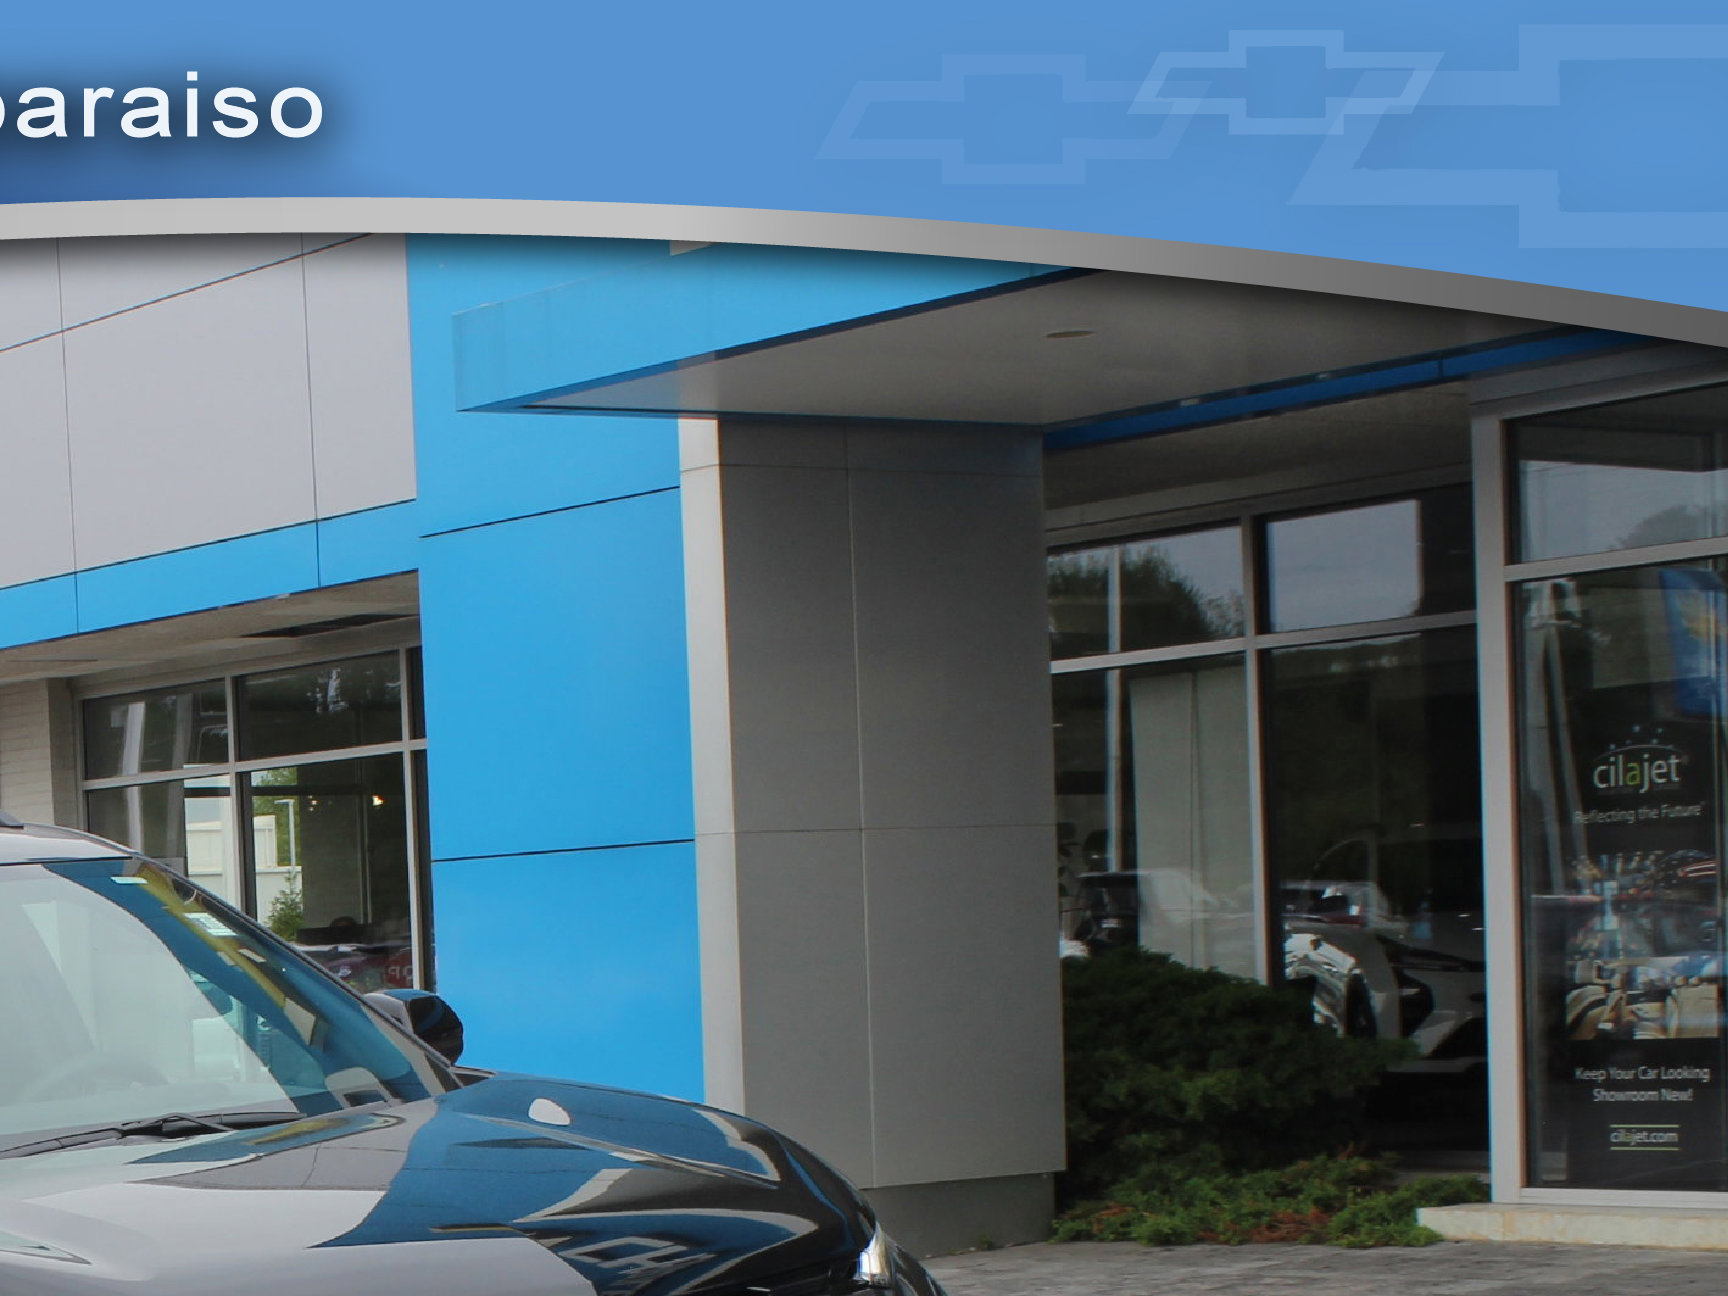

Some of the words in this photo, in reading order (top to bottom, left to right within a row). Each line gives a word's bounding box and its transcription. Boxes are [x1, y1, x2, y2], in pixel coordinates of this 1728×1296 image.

[1593, 753, 1681, 794] cilajet
[1575, 1066, 1607, 1083] Keep
[1608, 1066, 1637, 1080] Your
[1638, 1065, 1659, 1080] Car
[1660, 1066, 1710, 1083] Looking
[1593, 1088, 1659, 1101] Showroom
